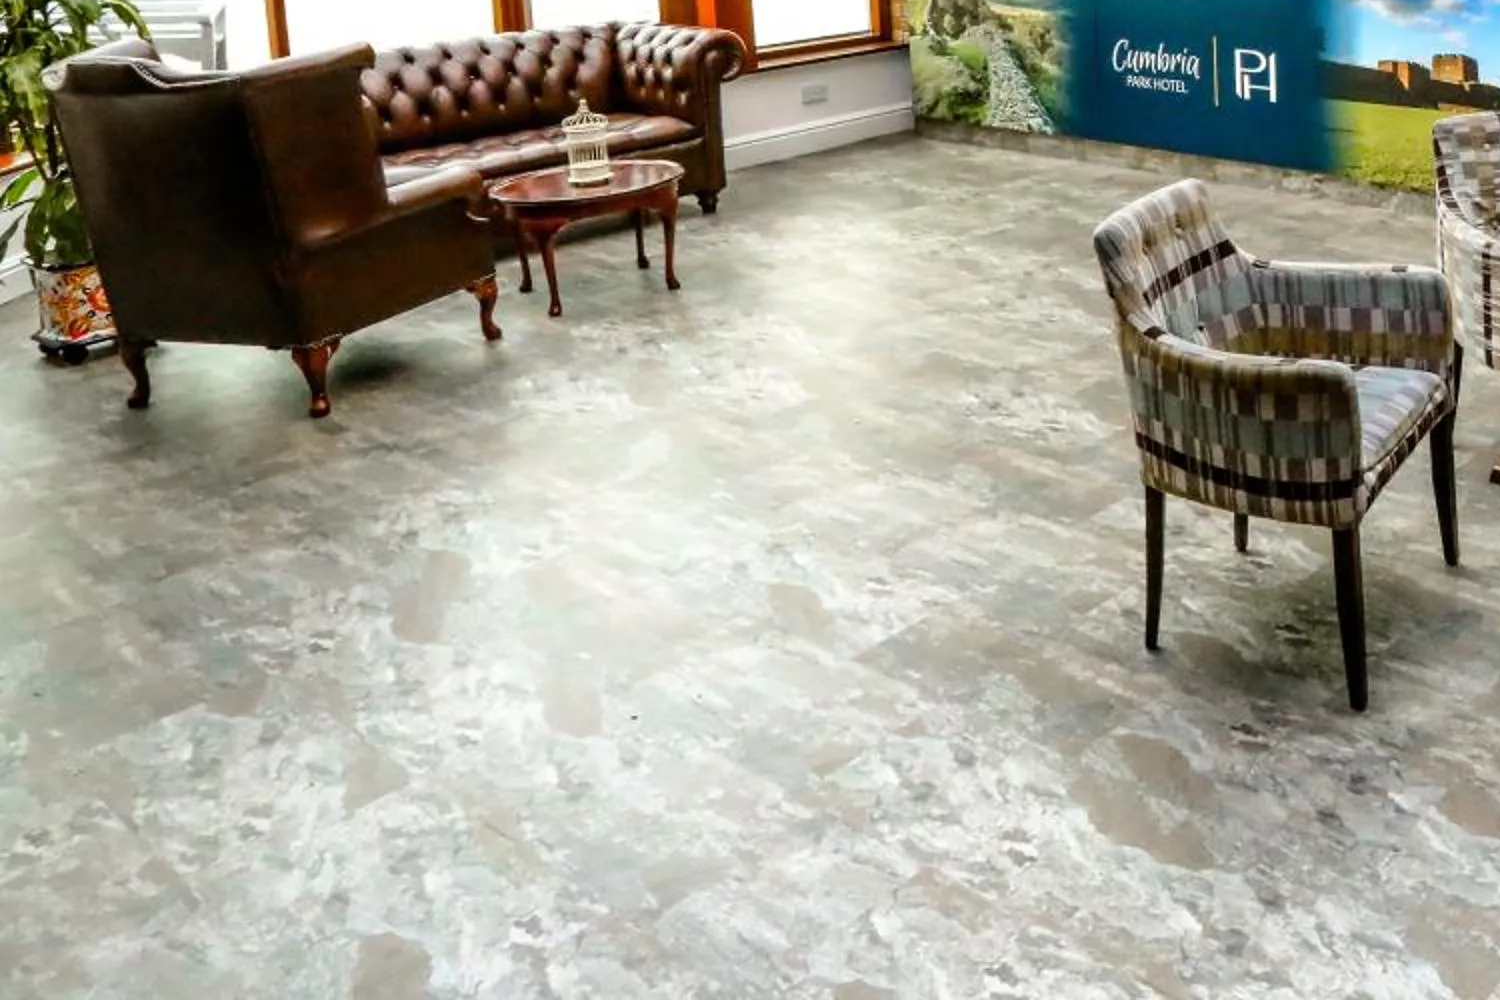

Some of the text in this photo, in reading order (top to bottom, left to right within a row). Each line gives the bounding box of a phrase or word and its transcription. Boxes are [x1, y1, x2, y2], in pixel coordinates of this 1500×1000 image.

[1112, 38, 1201, 80] Cumbria
[1126, 75, 1189, 94] PARK HOTEL
